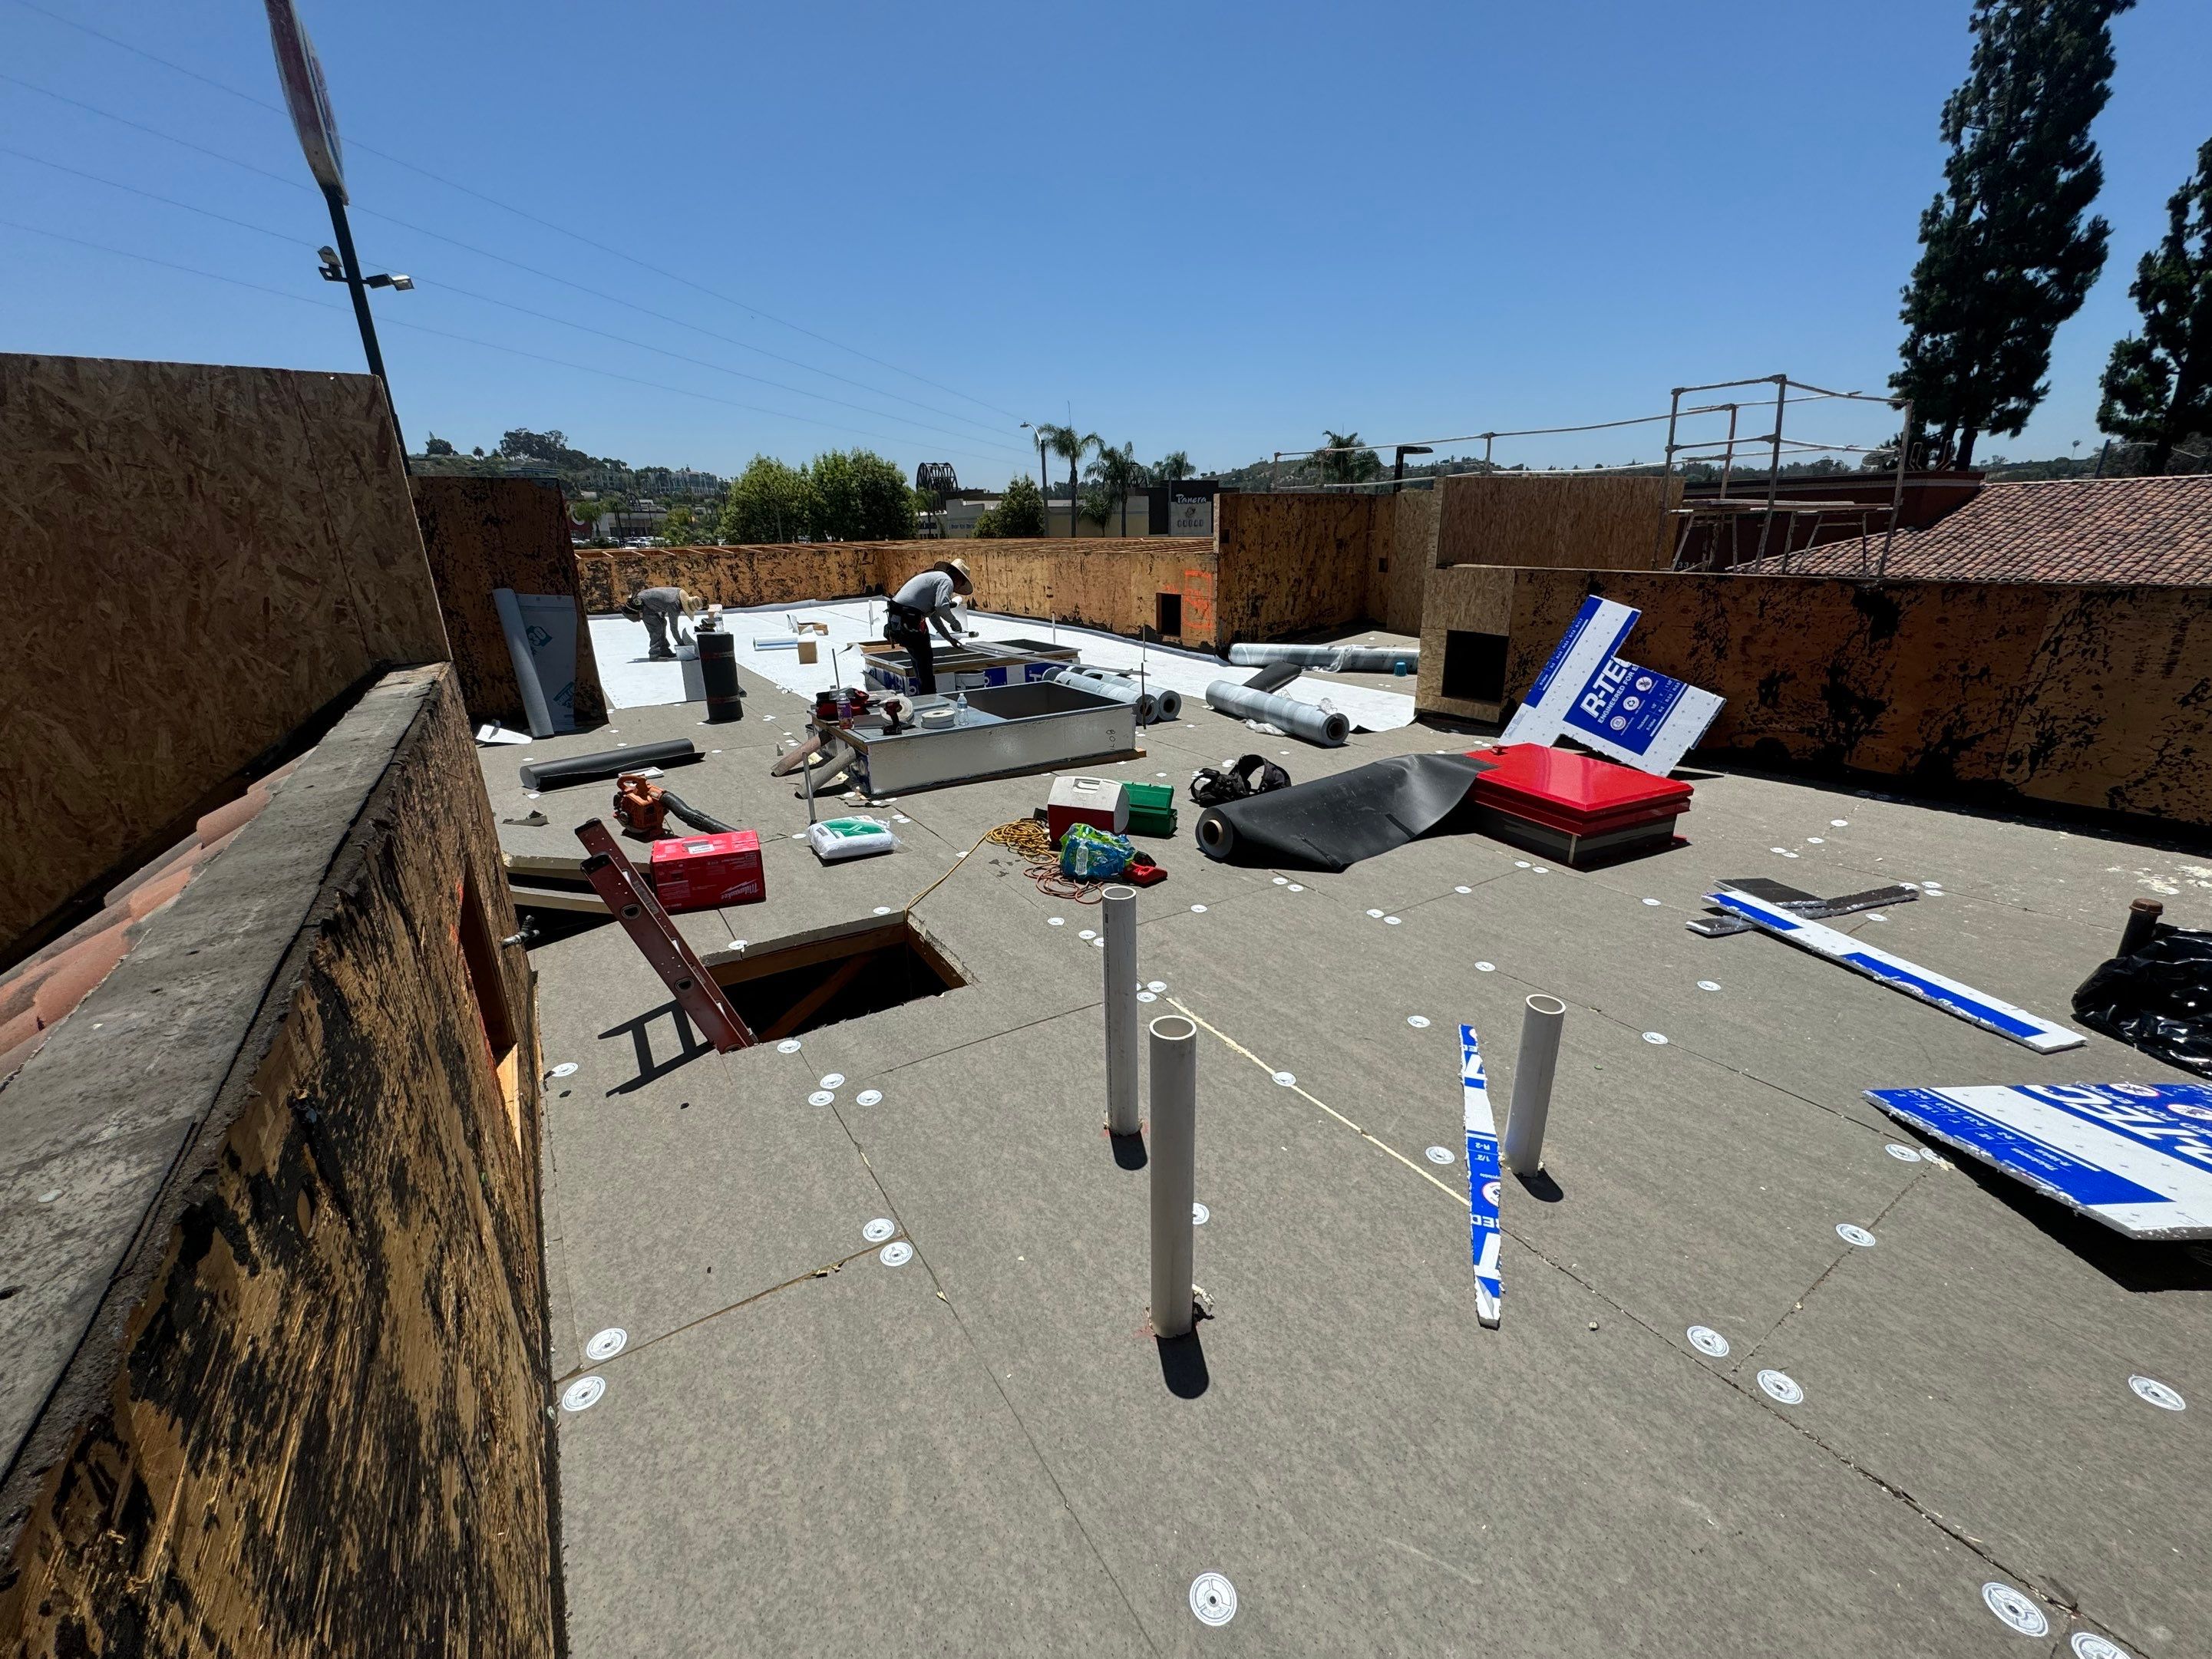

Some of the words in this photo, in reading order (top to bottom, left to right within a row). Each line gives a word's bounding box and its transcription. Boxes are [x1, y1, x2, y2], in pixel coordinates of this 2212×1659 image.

[1176, 493, 1207, 503] Panera
[1597, 685, 1626, 724] ENGINEERED
[1623, 671, 1635, 685] FOR
[721, 882, 761, 899] Milwaukee
[2134, 1106, 2180, 1120] FOR
[1475, 1142, 1491, 1150] R-2
